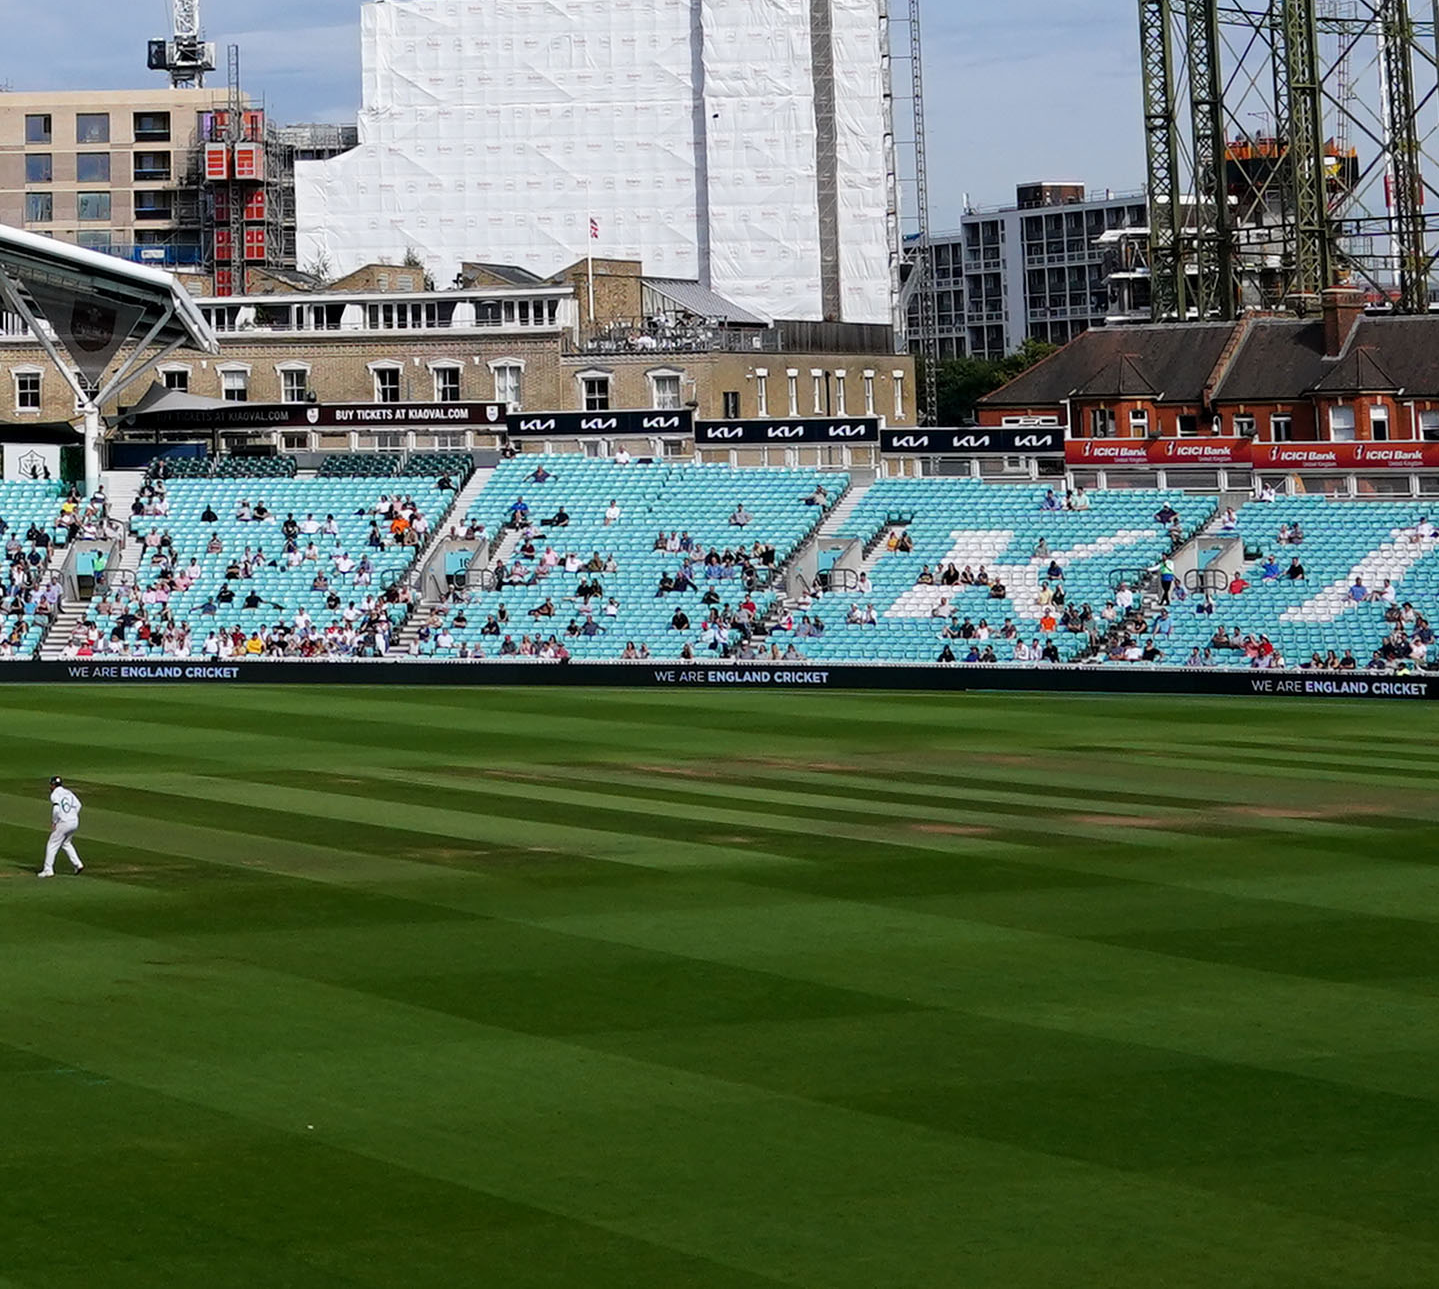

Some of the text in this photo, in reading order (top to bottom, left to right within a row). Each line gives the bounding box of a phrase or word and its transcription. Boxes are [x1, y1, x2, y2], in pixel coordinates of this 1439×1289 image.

[336, 408, 468, 420] BUY TICKETS AT KIAOVAL.COM
[1094, 448, 1146, 456] ICICI Bank
[1177, 447, 1231, 455] ICICI Bank
[1366, 451, 1422, 460] ICICI Bank
[1281, 452, 1336, 460] ICICI Bank
[68, 667, 239, 678] WE ARE ENGLAND CRICKET
[1251, 680, 1427, 695] WE ARE ENGLAND CRICKET
